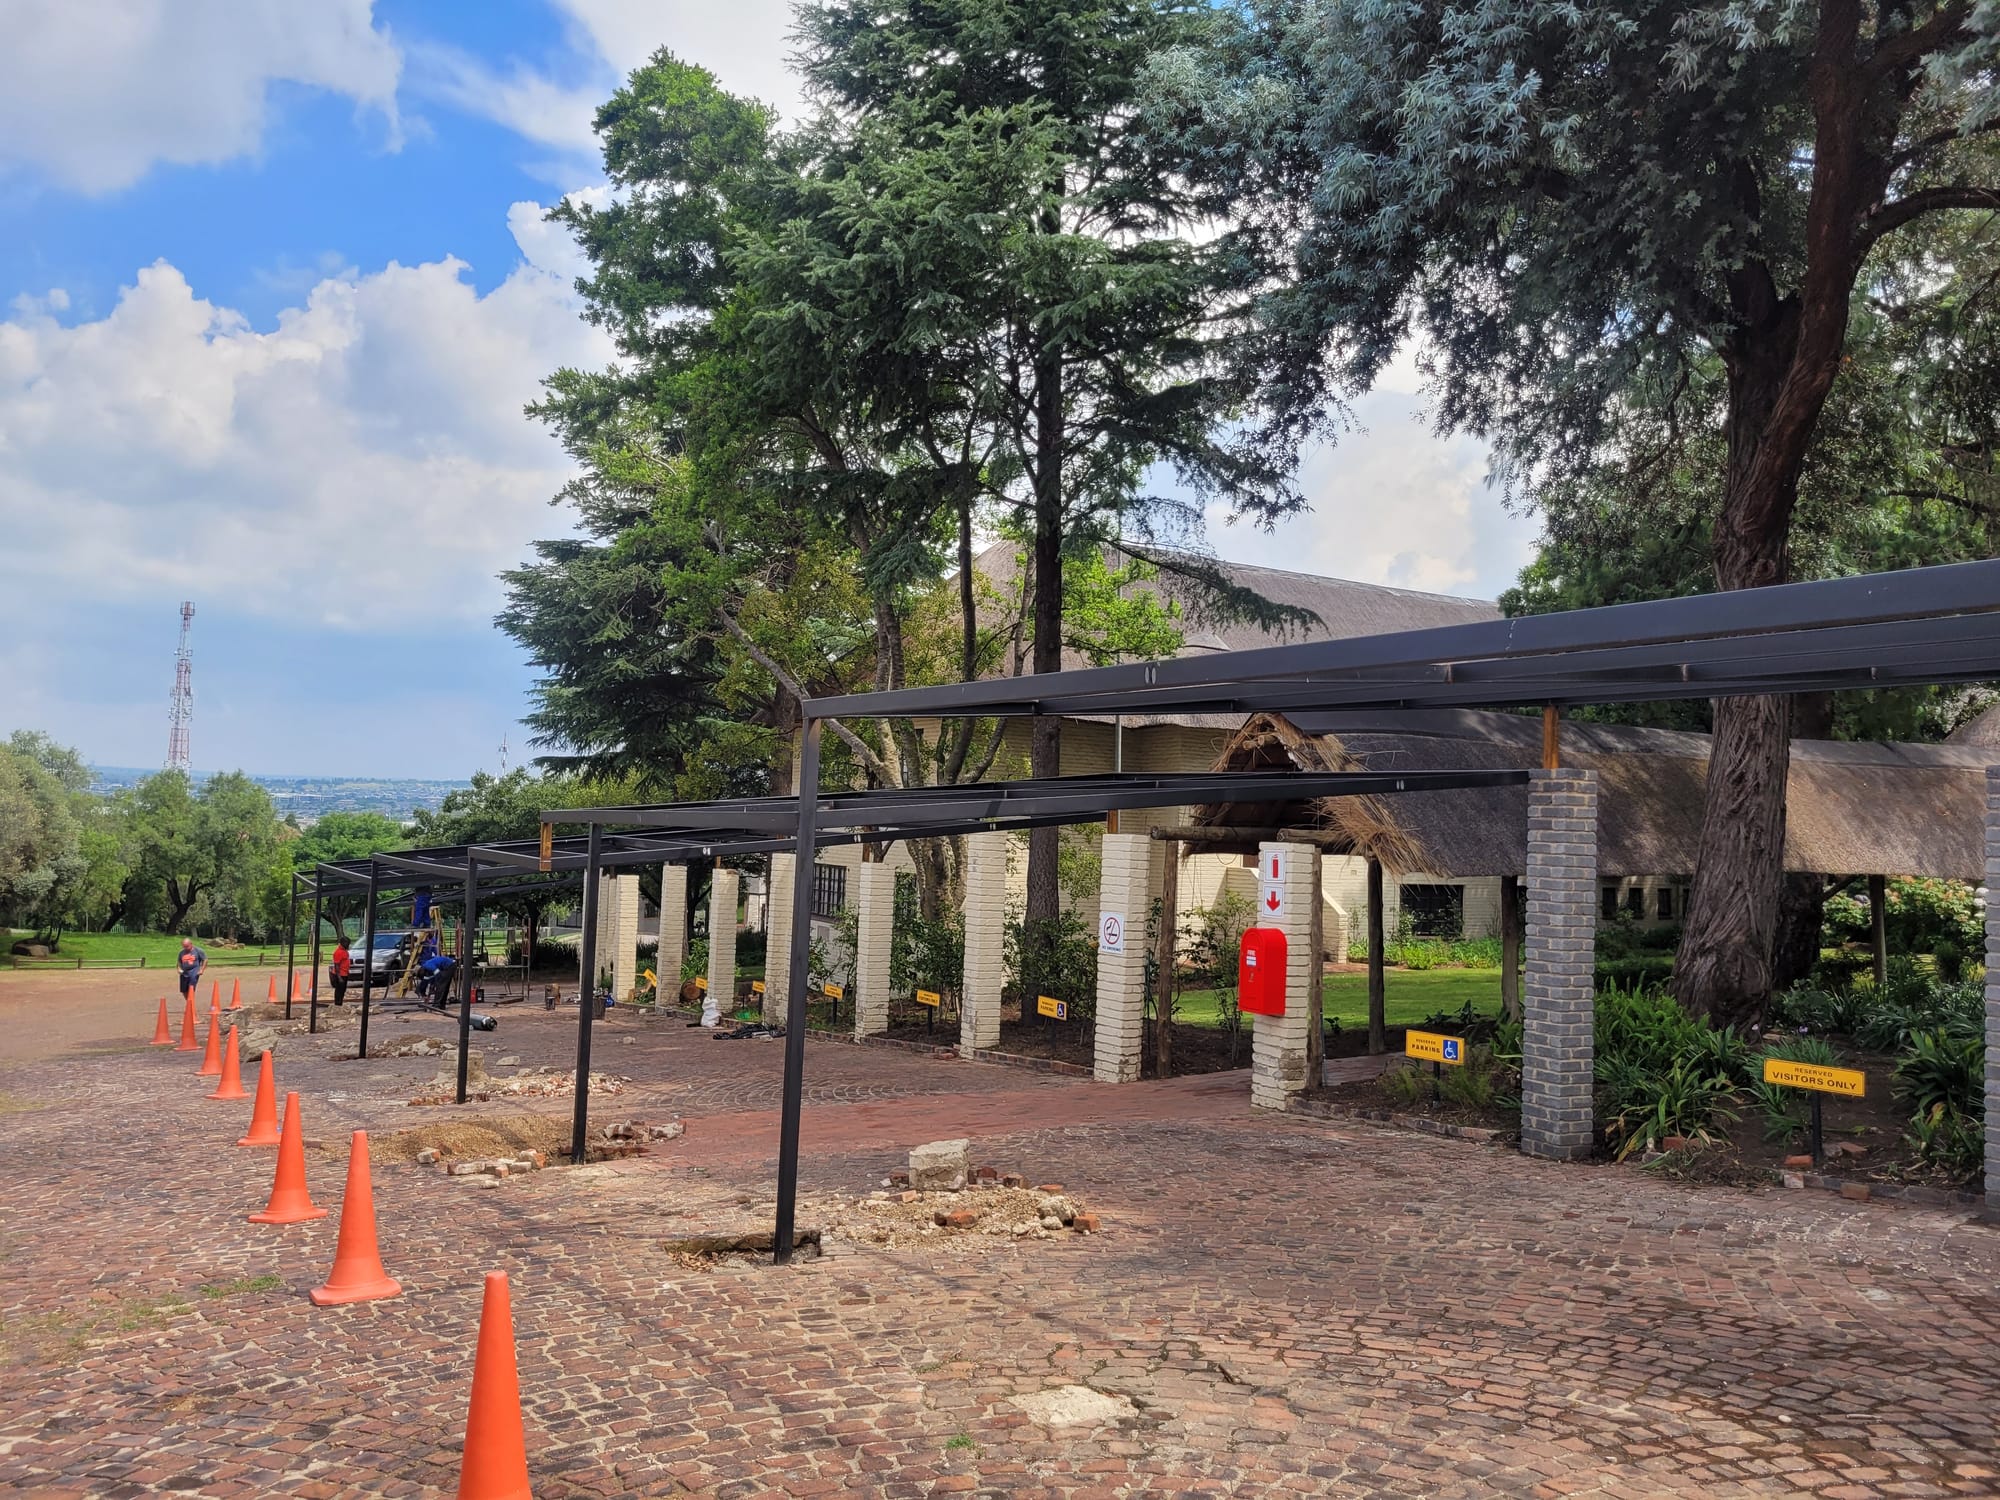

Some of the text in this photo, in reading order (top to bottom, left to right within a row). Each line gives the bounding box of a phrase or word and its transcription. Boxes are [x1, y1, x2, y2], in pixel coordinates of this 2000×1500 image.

[1411, 1044, 1440, 1053] PARKING
[1794, 1067, 1833, 1078] RESERVED
[1772, 1071, 1857, 1090] VISITORS ONLY
